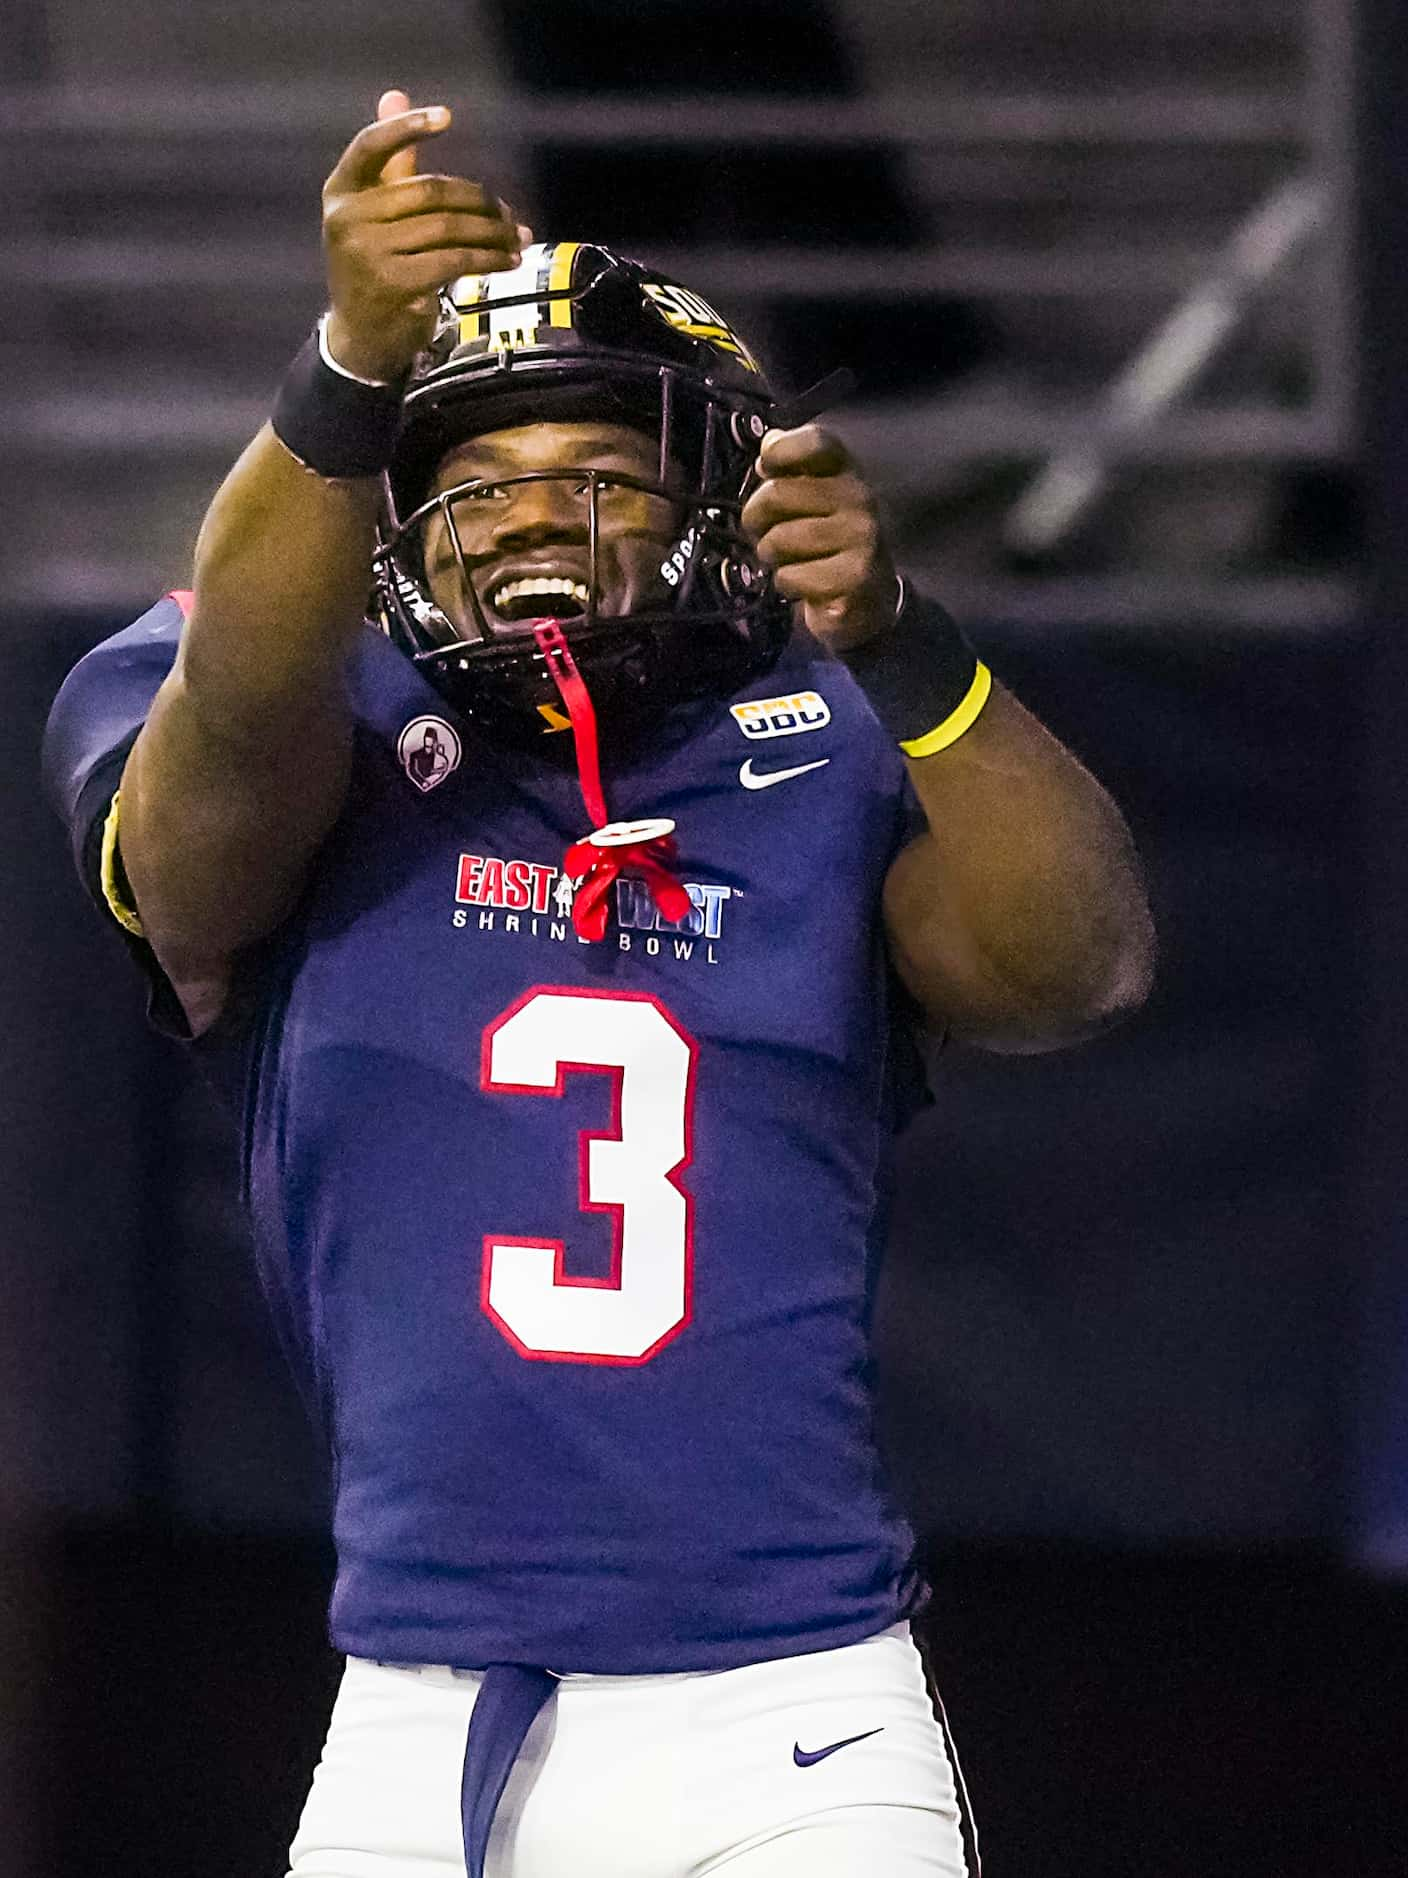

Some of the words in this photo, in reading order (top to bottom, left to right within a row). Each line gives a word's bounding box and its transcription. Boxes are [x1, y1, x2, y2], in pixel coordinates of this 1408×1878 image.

[455, 854, 558, 914] EAST
[453, 910, 590, 944] SHRIN
[619, 933, 718, 964] BOWL
[481, 984, 698, 1367] 3
